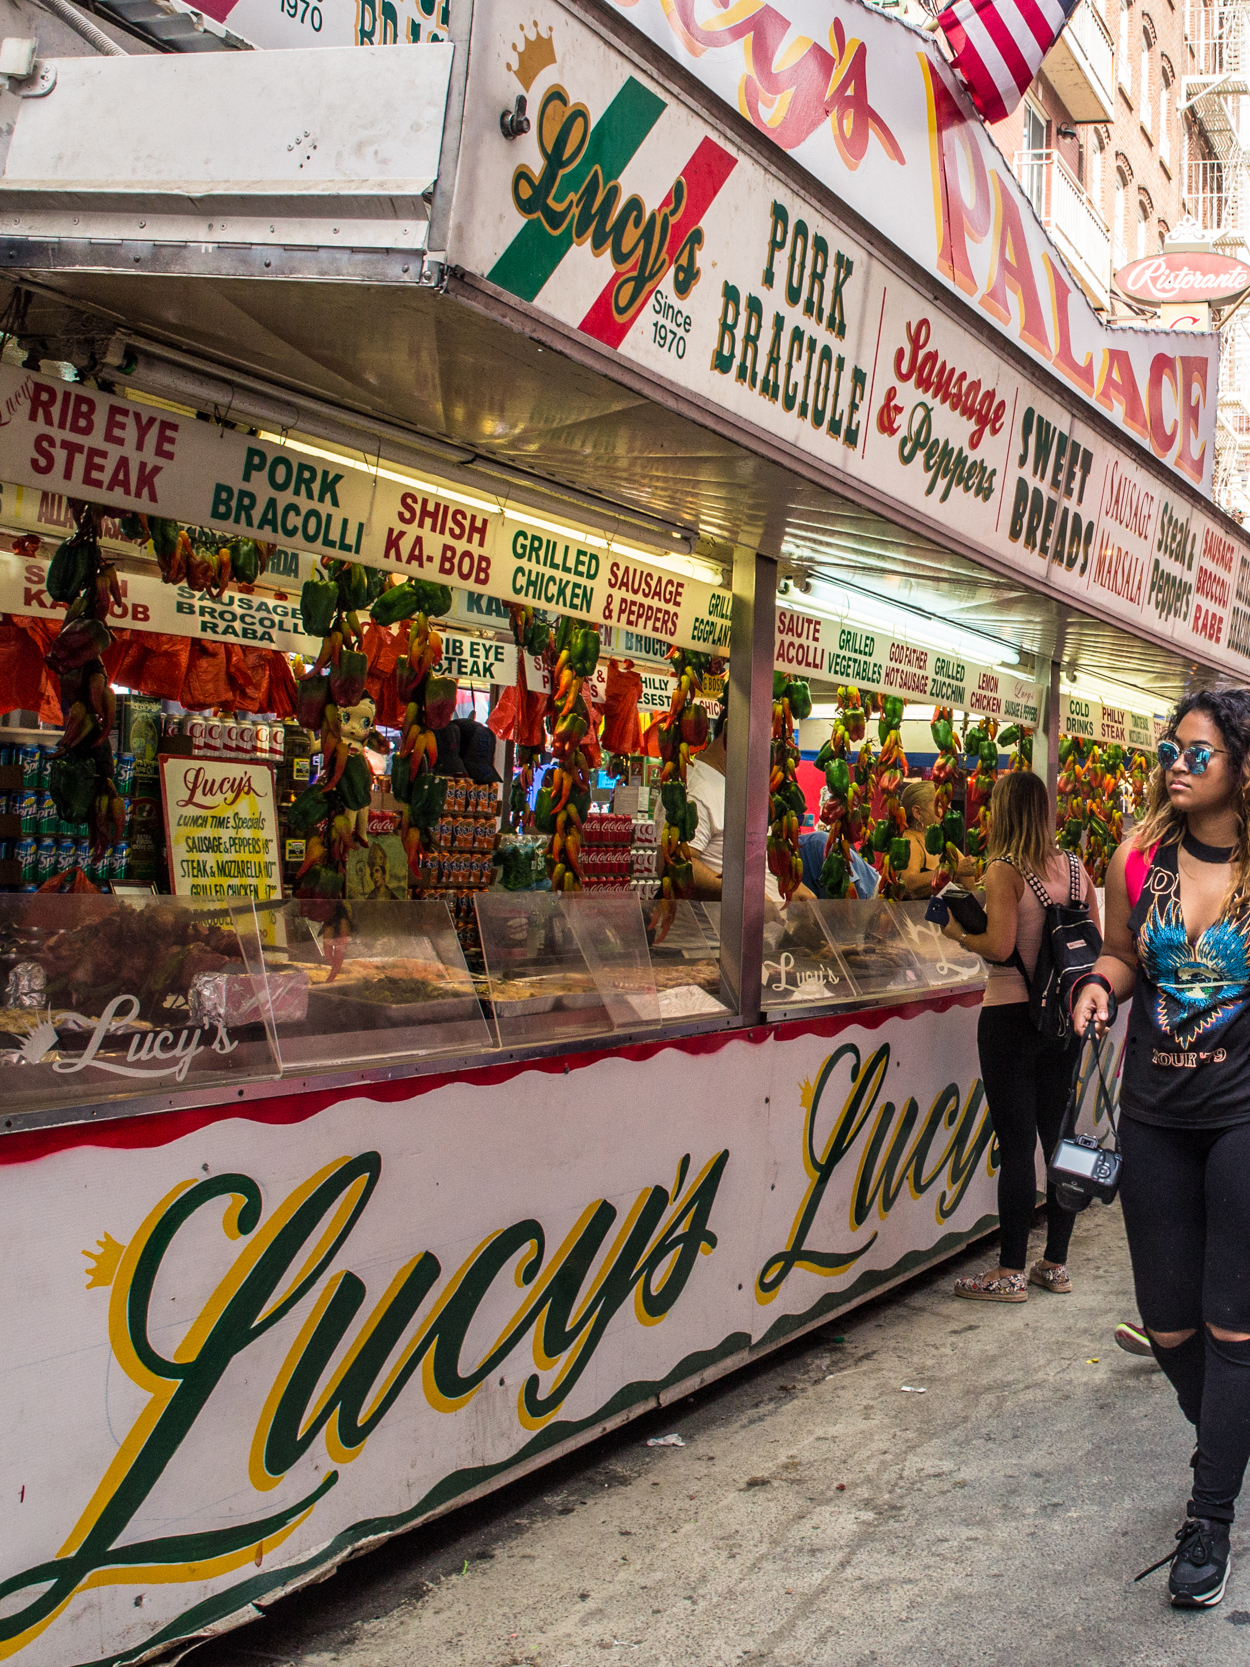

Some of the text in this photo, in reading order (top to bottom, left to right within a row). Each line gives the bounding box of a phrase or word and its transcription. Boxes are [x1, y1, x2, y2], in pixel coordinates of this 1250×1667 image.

[512, 84, 705, 324] Lucy's
[762, 199, 853, 341] PORK
[916, 50, 1209, 484] PALACE
[1127, 257, 1248, 298] Ristorante
[653, 289, 692, 333] Since
[653, 321, 687, 359] 1970
[710, 280, 867, 451] BRACIOLE
[894, 318, 1006, 451] Sausage
[28, 382, 179, 461] RIB EYE
[876, 386, 997, 502] & Peppers
[1018, 406, 1094, 507] SWEET
[30, 433, 164, 503] STEAK
[242, 446, 344, 508] PORK
[210, 483, 364, 555] BRACOLLI
[397, 492, 488, 548] SHISH
[1105, 460, 1154, 541] SAUSAGE
[1008, 476, 1095, 578] BREADS
[1157, 501, 1197, 571] Steak &
[512, 530, 600, 580] GRILLED
[1093, 528, 1145, 606] MARSALA
[1203, 527, 1234, 574] SAUSAGE
[512, 566, 594, 614] CHICKEN
[608, 561, 684, 608] SAUSAGE
[1147, 558, 1192, 622] Peppers
[1196, 565, 1230, 610] BROCCOLI
[201, 620, 276, 644] RABA
[603, 593, 614, 621] &
[617, 596, 679, 637] PEPPERS
[778, 611, 821, 643] SAUTE
[1191, 604, 1224, 644] RABE
[470, 642, 504, 662] EYE
[839, 628, 875, 657] GRILLED
[432, 656, 495, 679] STEAK
[828, 652, 882, 684] VEGETABLES
[884, 665, 928, 695] HOT SAUSAGE
[935, 657, 965, 683] GRILLED
[978, 673, 999, 694] LEMON
[930, 678, 966, 705] ZUCCHINI
[970, 691, 1001, 714] CHICKEN
[1004, 699, 1020, 716] SAUSAGE
[1023, 705, 1037, 722] PEPPERS
[1069, 700, 1089, 718] COLD
[1066, 717, 1093, 736] DRINKS
[1101, 723, 1125, 741] STEAK
[1102, 707, 1125, 725] PHILLY
[176, 767, 267, 809] Lucy's
[177, 811, 266, 835] LUNCH TIME Specials
[185, 836, 222, 853] SAUSAGE
[223, 841, 229, 853] &
[228, 836, 261, 854] PEPPERS
[181, 860, 209, 878] STEAK
[210, 865, 215, 877] &
[216, 860, 263, 878] MOZZARELLA
[190, 883, 225, 902] GRILLED
[227, 883, 259, 900] CHICKEN
[53, 995, 238, 1082] Lucy's
[0, 1150, 729, 1660] Lucy's
